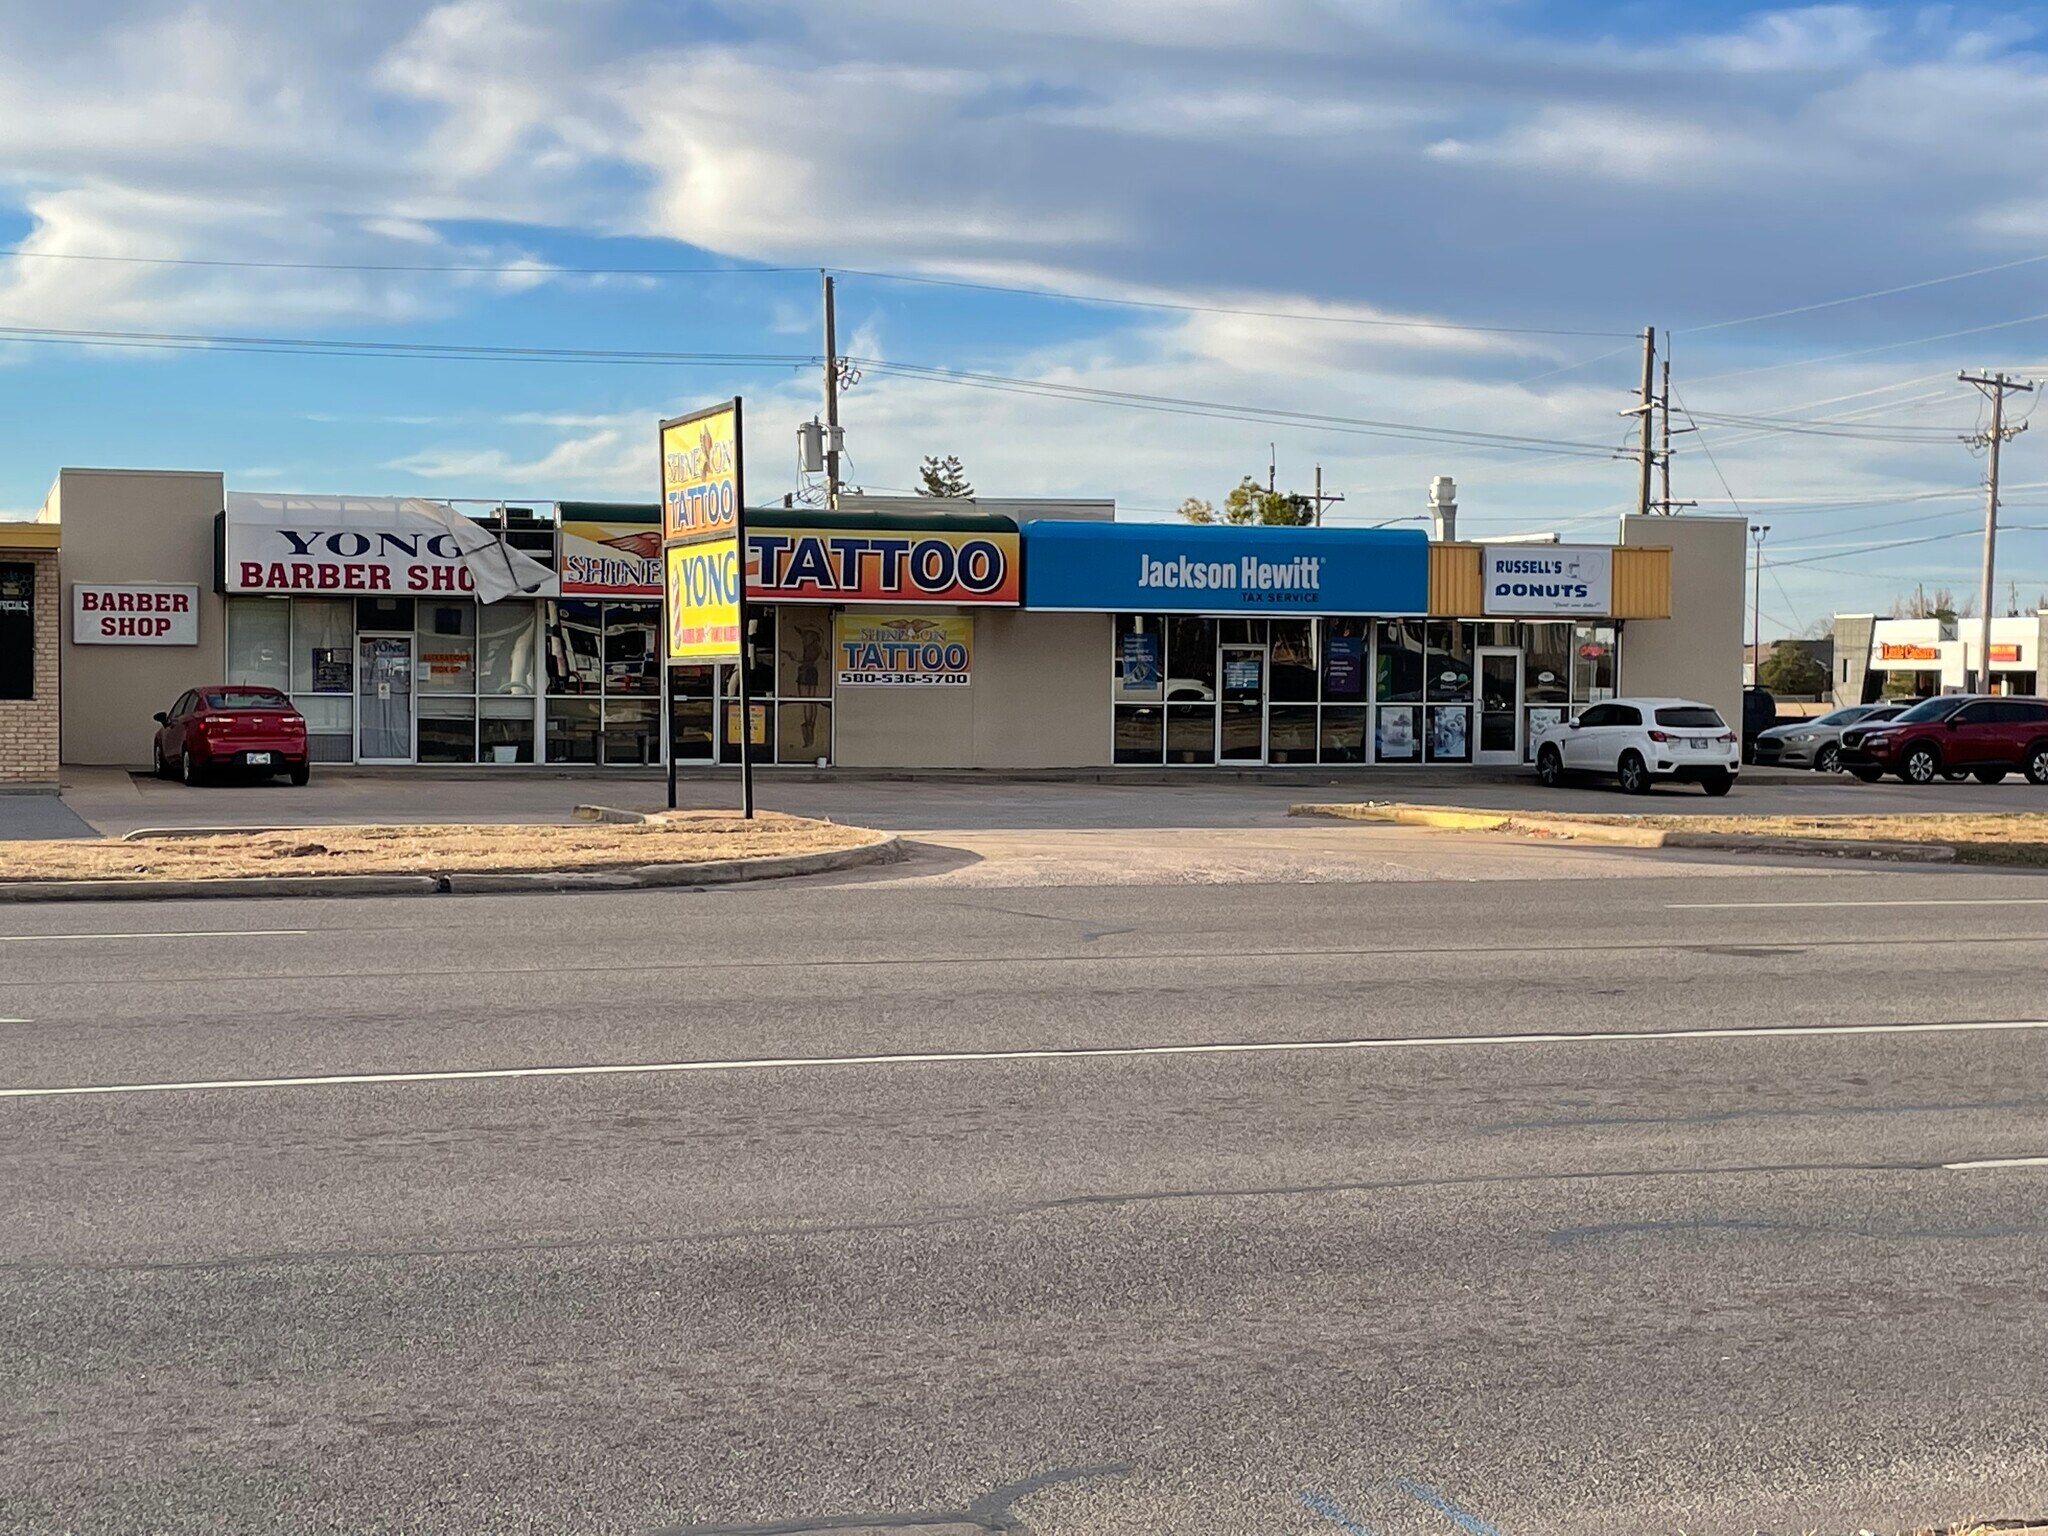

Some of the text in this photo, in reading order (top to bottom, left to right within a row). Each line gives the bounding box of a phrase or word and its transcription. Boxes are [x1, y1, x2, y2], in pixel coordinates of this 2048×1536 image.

[667, 439, 734, 483] SHINE ON
[668, 479, 735, 532] TATTOO
[276, 530, 465, 558] YONG
[240, 562, 476, 591] BARBER SHO
[567, 555, 663, 586] SHINE
[747, 535, 1008, 593] TATTOO
[1138, 554, 1237, 590] Jackson
[1496, 560, 1562, 574] RUSSELL'S
[681, 550, 740, 608] YONG
[1495, 583, 1588, 598] DONUTS
[82, 592, 189, 612] BARBER
[1241, 592, 1319, 603] TAX SERVICE
[101, 617, 171, 636] SHOP
[842, 642, 969, 671] TATTOO
[841, 674, 967, 684] 580-536-5700
